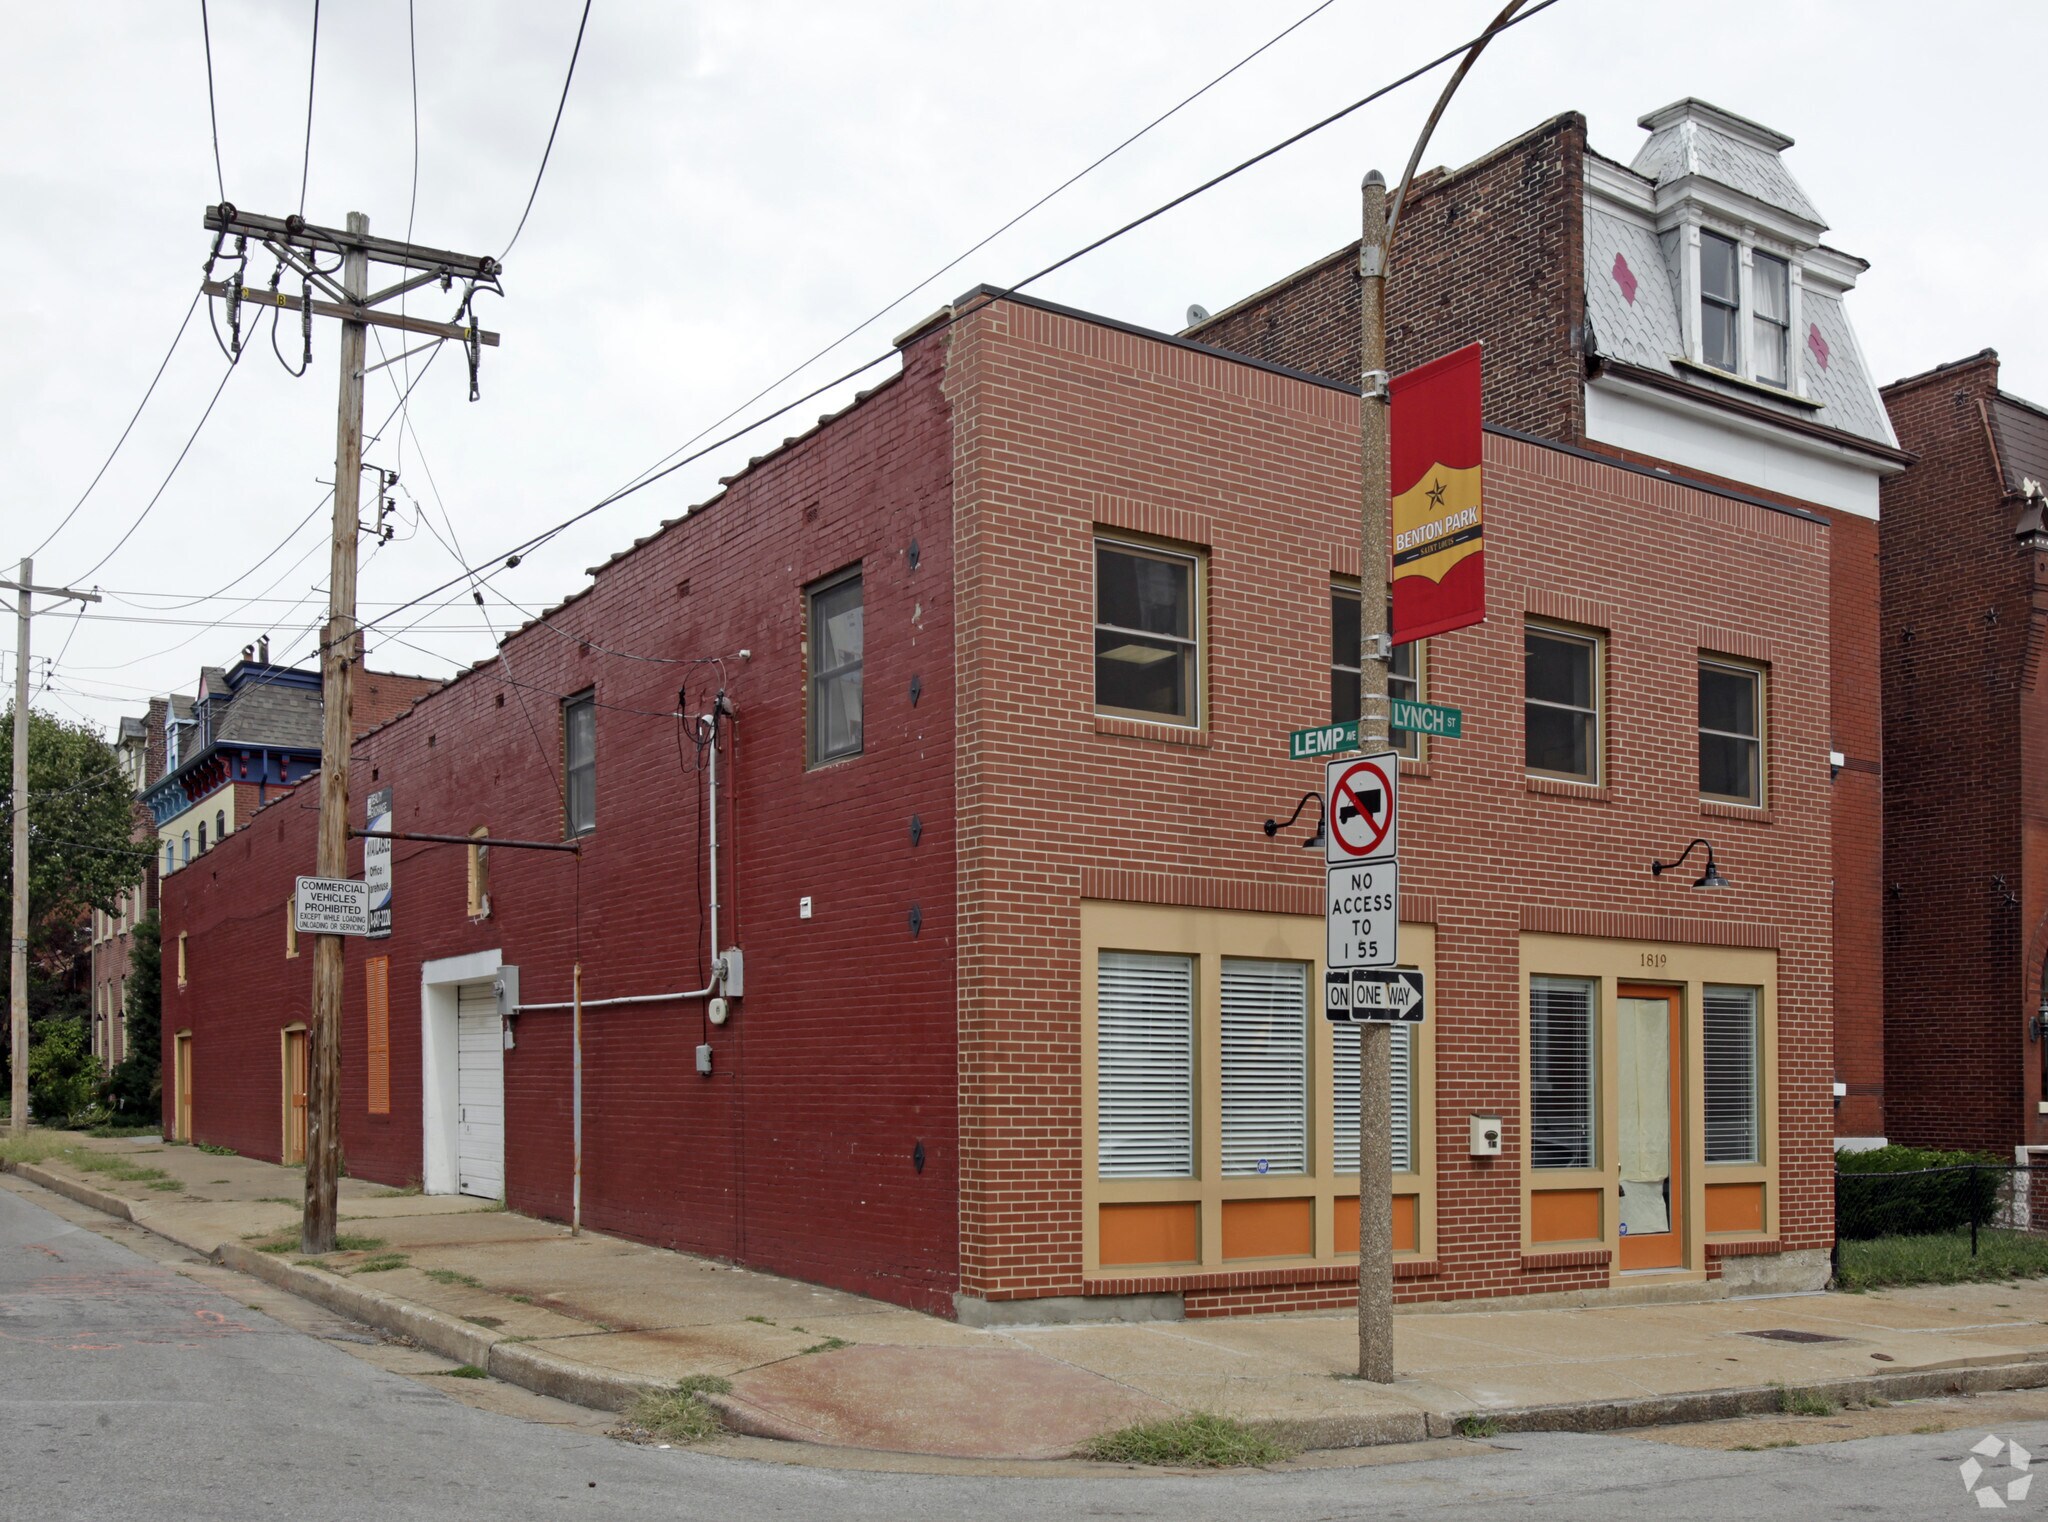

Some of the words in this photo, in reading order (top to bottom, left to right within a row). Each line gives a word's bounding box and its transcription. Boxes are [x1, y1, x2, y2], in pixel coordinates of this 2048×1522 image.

[1396, 520, 1443, 551] BENTON
[1445, 505, 1478, 533] PARK
[1420, 543, 1438, 556] SAINT
[1438, 537, 1454, 551] LOUIS
[1394, 702, 1444, 733] LYNCH
[1447, 717, 1456, 728] ST
[1295, 727, 1345, 756] LEMP
[1346, 730, 1356, 742] AVE
[369, 866, 383, 877] Office
[301, 881, 365, 894] COMMERCIAL
[369, 882, 389, 894] arehouse
[1351, 872, 1373, 891] NO
[310, 892, 357, 904] VEHICLES
[1332, 893, 1392, 915] ACCESS
[304, 902, 361, 915] PROHIBITED
[300, 912, 321, 921] EXCEPT
[323, 914, 340, 922] WHILE
[342, 915, 366, 924] LOADING
[300, 921, 328, 930] UNLOADING
[330, 922, 338, 930] OR
[340, 923, 366, 932] SERVICING
[1352, 919, 1372, 936] TO
[1345, 943, 1348, 959] I
[1358, 941, 1378, 959] 55
[1640, 952, 1667, 968] 1819
[1330, 986, 1348, 1006] ON
[1356, 984, 1382, 1005] ONE
[1388, 986, 1411, 1006] WAY
